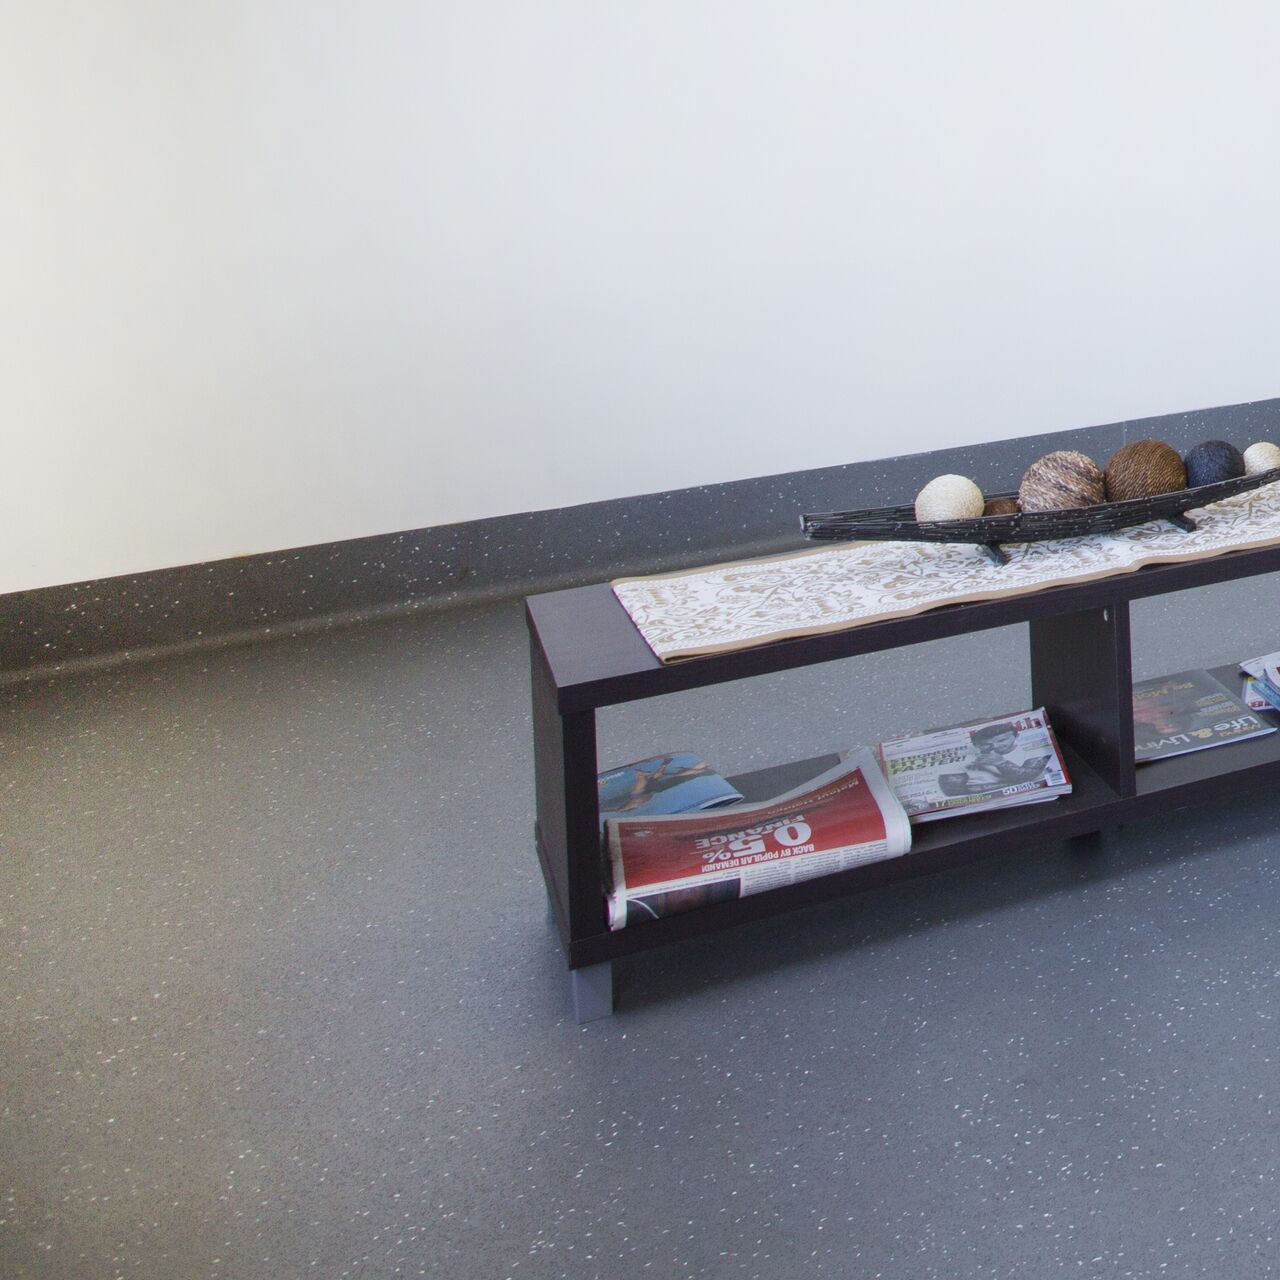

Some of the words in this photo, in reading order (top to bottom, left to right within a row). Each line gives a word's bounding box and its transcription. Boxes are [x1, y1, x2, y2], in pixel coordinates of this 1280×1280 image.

[1214, 715, 1259, 731] Life
[1134, 734, 1191, 752] Livin
[891, 755, 968, 775] FASTER!
[935, 799, 946, 808] 17
[696, 814, 806, 849] FINANCE
[740, 850, 779, 865] POPULAR
[780, 847, 792, 858] BY
[792, 844, 815, 856] BACK
[701, 855, 740, 873] DEMAND!
